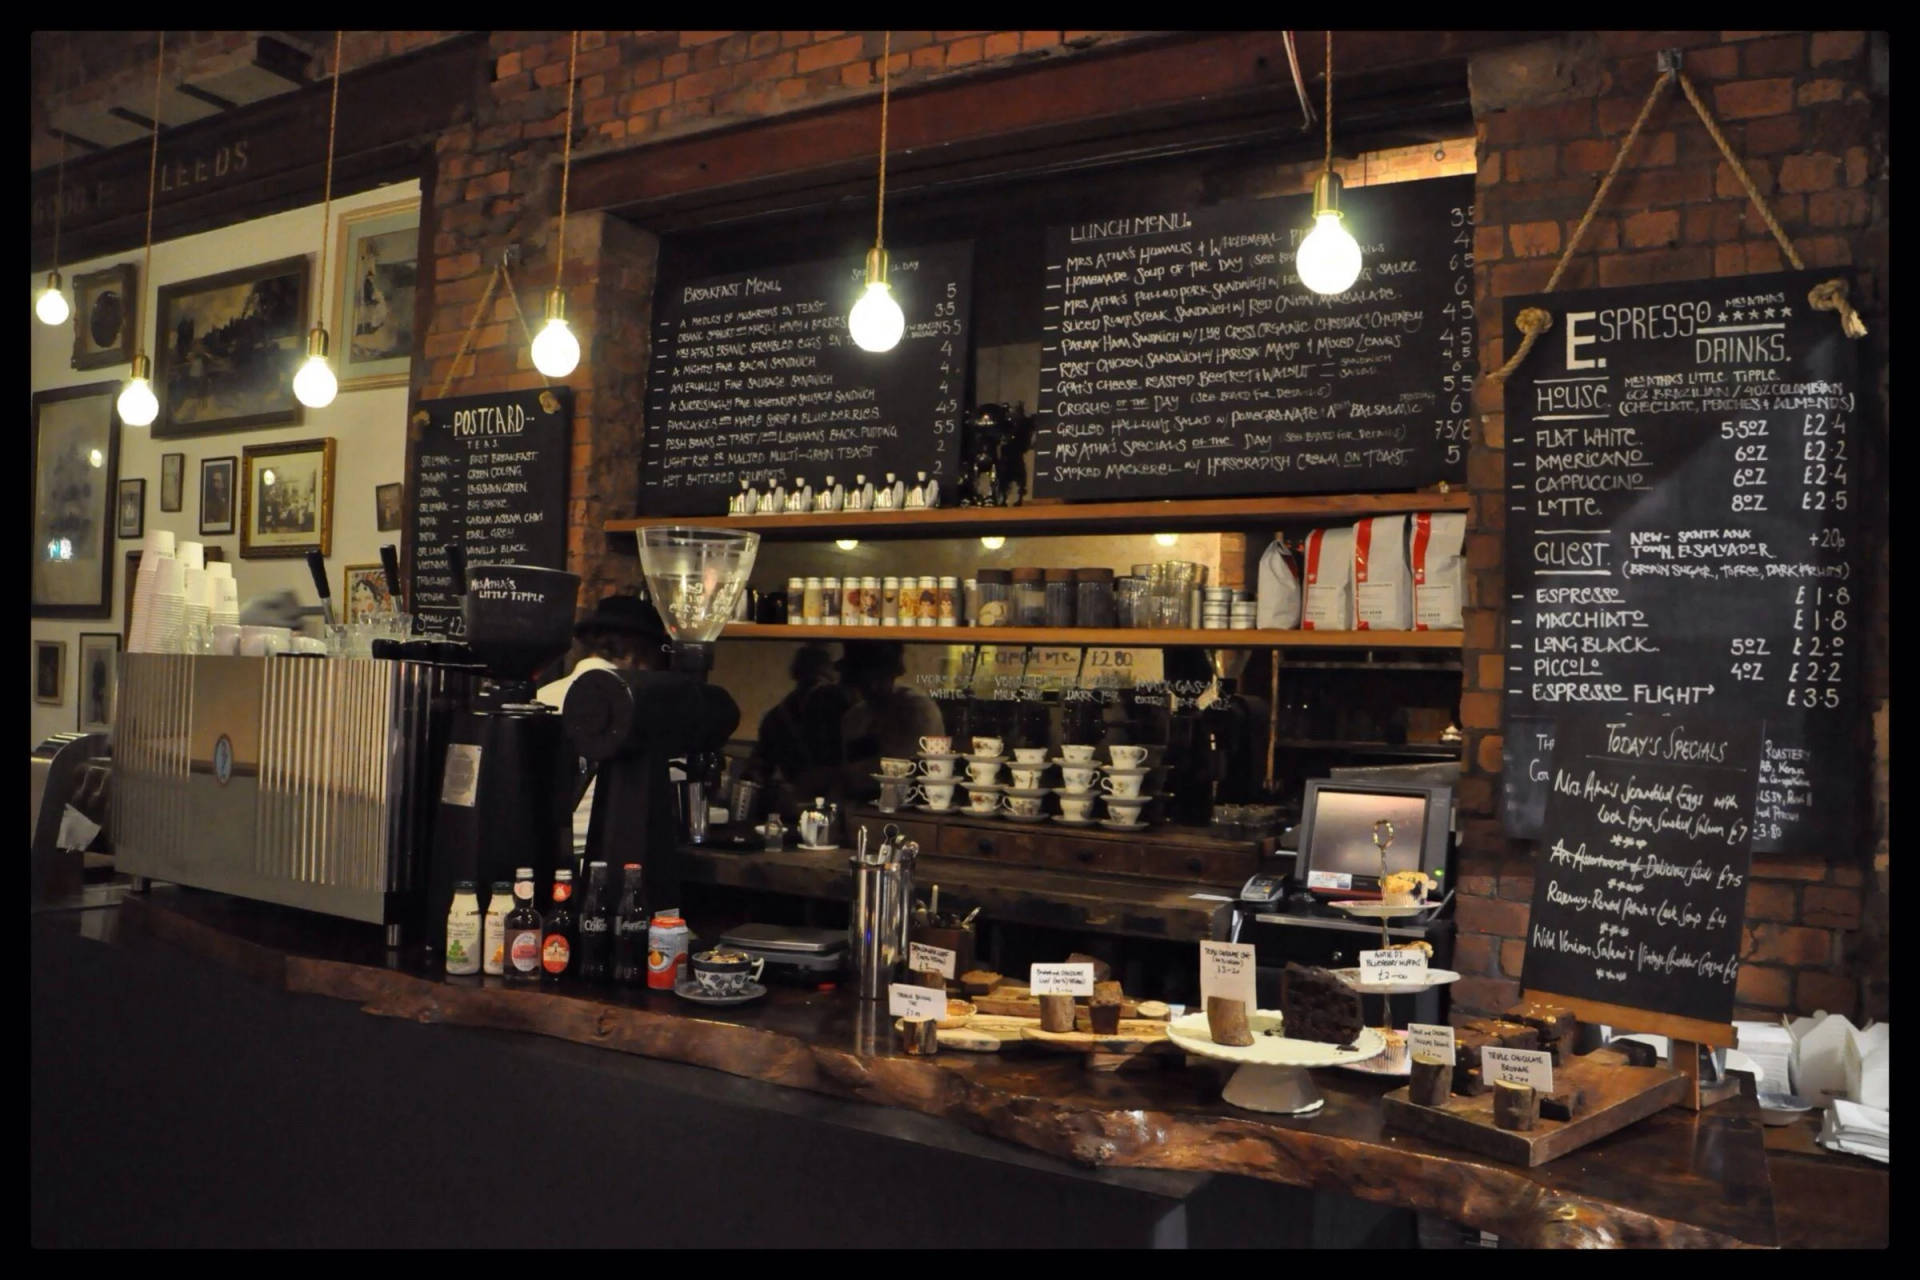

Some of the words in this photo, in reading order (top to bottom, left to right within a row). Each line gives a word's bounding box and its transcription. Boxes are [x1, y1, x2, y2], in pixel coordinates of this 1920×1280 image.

[162, 140, 248, 191] LEEDS
[1071, 218, 1131, 242] LUNCH
[1454, 230, 1470, 249] 4
[1067, 256, 1093, 272] MRS
[1065, 271, 1128, 295] HOMEMADE
[1134, 265, 1166, 285] SOUP
[1218, 257, 1243, 276] DAY
[1455, 276, 1468, 296] 6
[684, 282, 743, 304] BREAKFAST
[745, 277, 782, 296] MENU
[946, 282, 957, 298] 5
[1179, 283, 1212, 304] PORK
[1212, 275, 1268, 301] SANDWICH
[1062, 319, 1101, 333] SLICED
[1103, 313, 1131, 332] RUMP
[1132, 310, 1171, 327] STEAK
[1174, 301, 1231, 323] SANDWICH
[1249, 298, 1272, 317] RED
[940, 340, 952, 357] 4
[1061, 337, 1099, 357] PARMA
[1103, 334, 1131, 352] HAM
[1257, 321, 1310, 338] ORGANIC
[1265, 341, 1301, 361] MAYO
[1316, 337, 1354, 358] MIXED
[1355, 333, 1402, 353] LEAVES
[940, 361, 950, 375] 4
[1687, 371, 1727, 384] LITTLE
[939, 380, 949, 395] 4
[1096, 378, 1140, 390] CHEESE
[1058, 401, 1111, 417] CROQUE
[1154, 395, 1179, 413] DAY
[1451, 394, 1462, 413] 6
[1703, 397, 1761, 412] PEACHES
[454, 403, 525, 437] POSTCARD
[1057, 422, 1104, 438] GRILLED
[1174, 415, 1211, 432] SALAD
[937, 440, 945, 452] 2
[1120, 439, 1186, 457] SPECIALS
[1245, 433, 1271, 453] DAY
[1536, 428, 1578, 448] FLAT
[1445, 445, 1460, 464] 5
[1536, 450, 1645, 472] AMERICANO
[933, 460, 942, 475] 2
[1054, 466, 1101, 482] SMOKED
[1105, 463, 1178, 479] MACKEREL
[1208, 456, 1291, 477] HORSERADISH
[1297, 453, 1340, 471] CREAM
[1535, 473, 1645, 493] CAPPUCCINO
[1678, 529, 1720, 543] SANTA
[1723, 528, 1751, 541] ANA
[1766, 562, 1799, 578] DARK
[479, 590, 508, 599] LITTLE
[511, 591, 545, 602] TIPPLE
[1536, 587, 1625, 604] ESPRESSO
[1536, 608, 1648, 629] MACCHIATO
[1534, 636, 1577, 654] LONG
[1534, 657, 1603, 677] PICCOLO
[1532, 683, 1628, 703] ESPRESSO
[1633, 684, 1704, 705] FLIGHT
[1676, 784, 1704, 812] Eggs
[1706, 906, 1728, 931] £4
